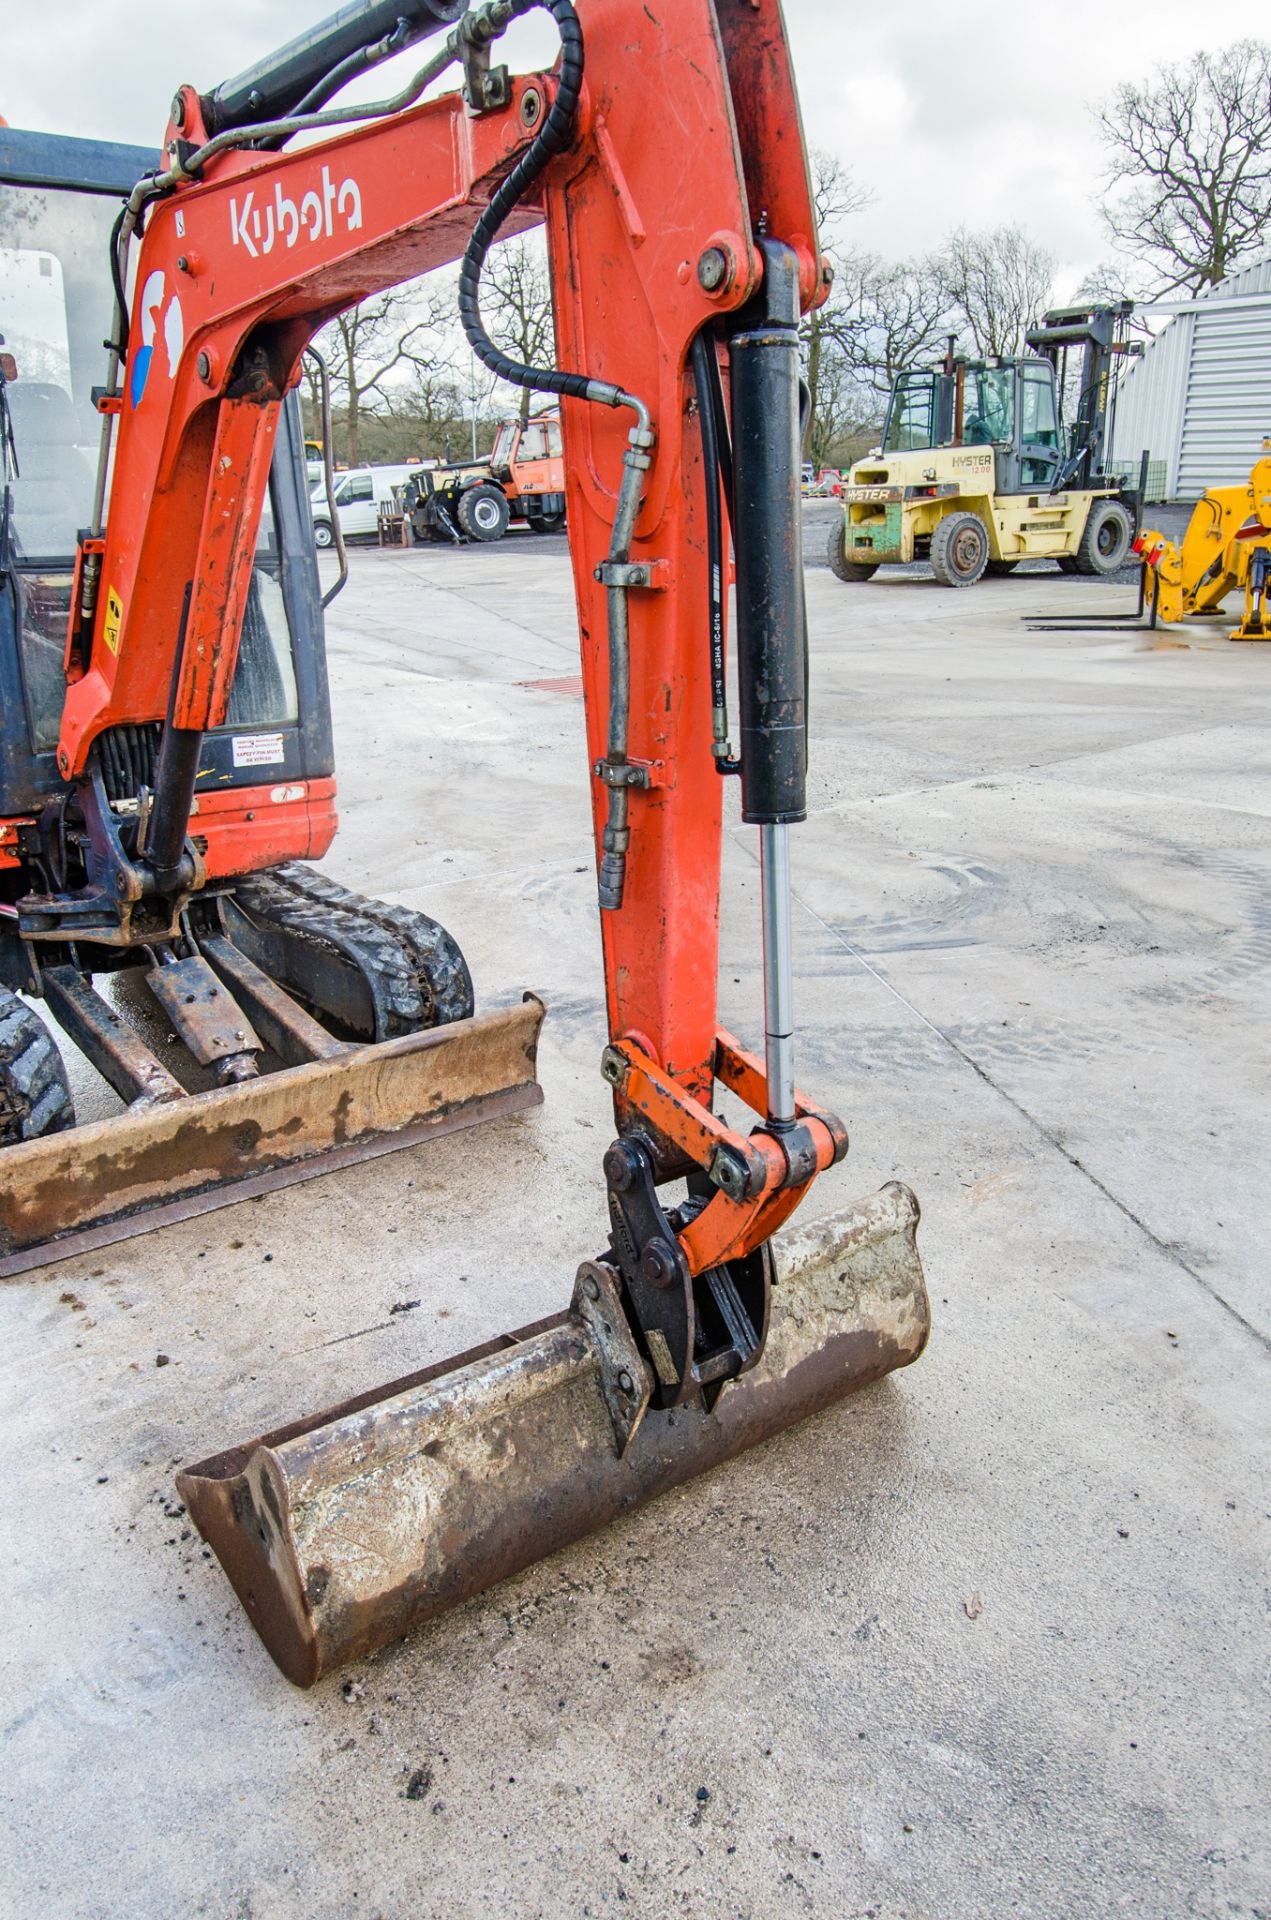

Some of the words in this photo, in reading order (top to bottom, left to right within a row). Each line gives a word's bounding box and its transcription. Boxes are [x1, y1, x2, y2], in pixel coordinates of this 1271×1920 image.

[229, 165, 362, 257] Kubota
[1099, 370, 1107, 413] HYSTER
[951, 455, 991, 467] HYSTER
[847, 488, 890, 501] HYSTER
